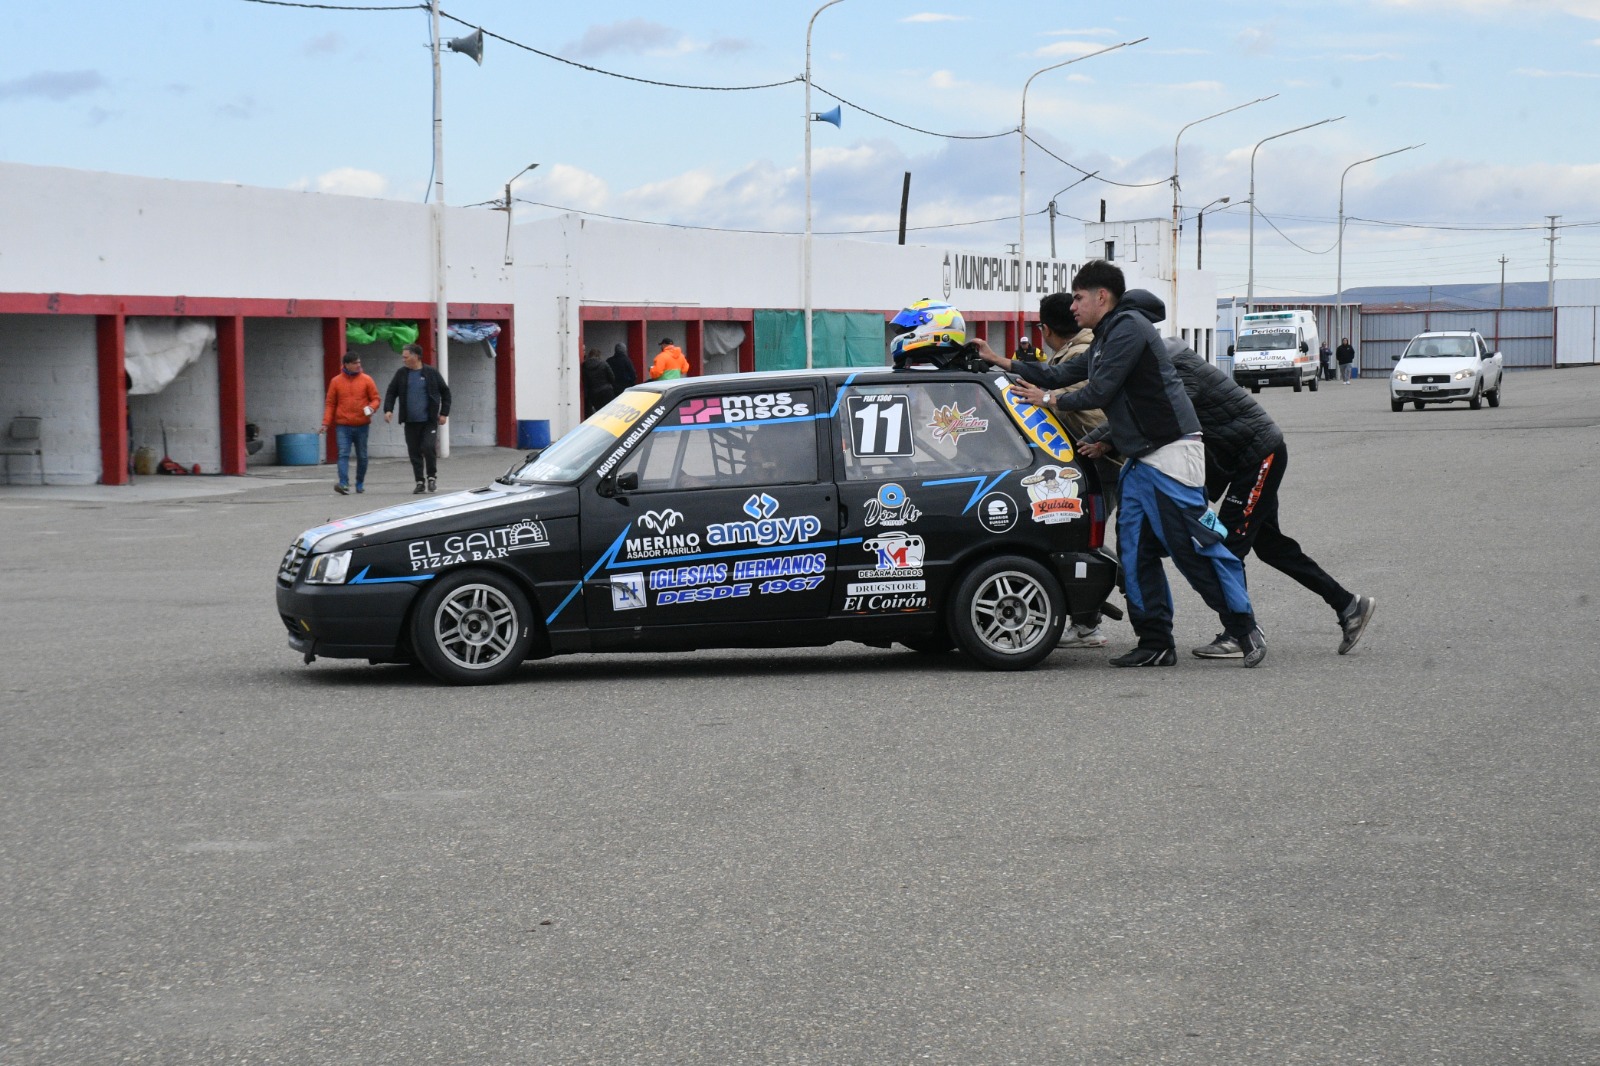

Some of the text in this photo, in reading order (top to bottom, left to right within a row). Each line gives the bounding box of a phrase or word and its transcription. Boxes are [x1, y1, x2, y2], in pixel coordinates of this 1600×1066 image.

[955, 254, 1032, 293] MUNICIPALIDD
[1036, 261, 1049, 293] DE
[1053, 263, 1067, 293] RIO
[722, 392, 793, 409] mas
[877, 394, 893, 402] 1300
[723, 403, 810, 423] pisos
[1005, 388, 1071, 457] CLICK
[855, 403, 903, 453] 11
[596, 405, 666, 478] AGUSTIN ORELLANA B+
[1038, 499, 1075, 513] Luisito
[408, 520, 543, 560] EL GAITA
[706, 515, 821, 545] amgyp
[626, 533, 700, 553] MERINO
[626, 546, 702, 560] ASADOR PARRILLA
[411, 547, 510, 571] PIZZA BAR
[649, 553, 826, 590] IGLESIAS HERMANOS
[858, 569, 923, 578] DESARMADEROS
[656, 575, 825, 606] DESDE 1967
[855, 582, 919, 593] DRUGSTORE
[842, 593, 927, 611] El Coirón
